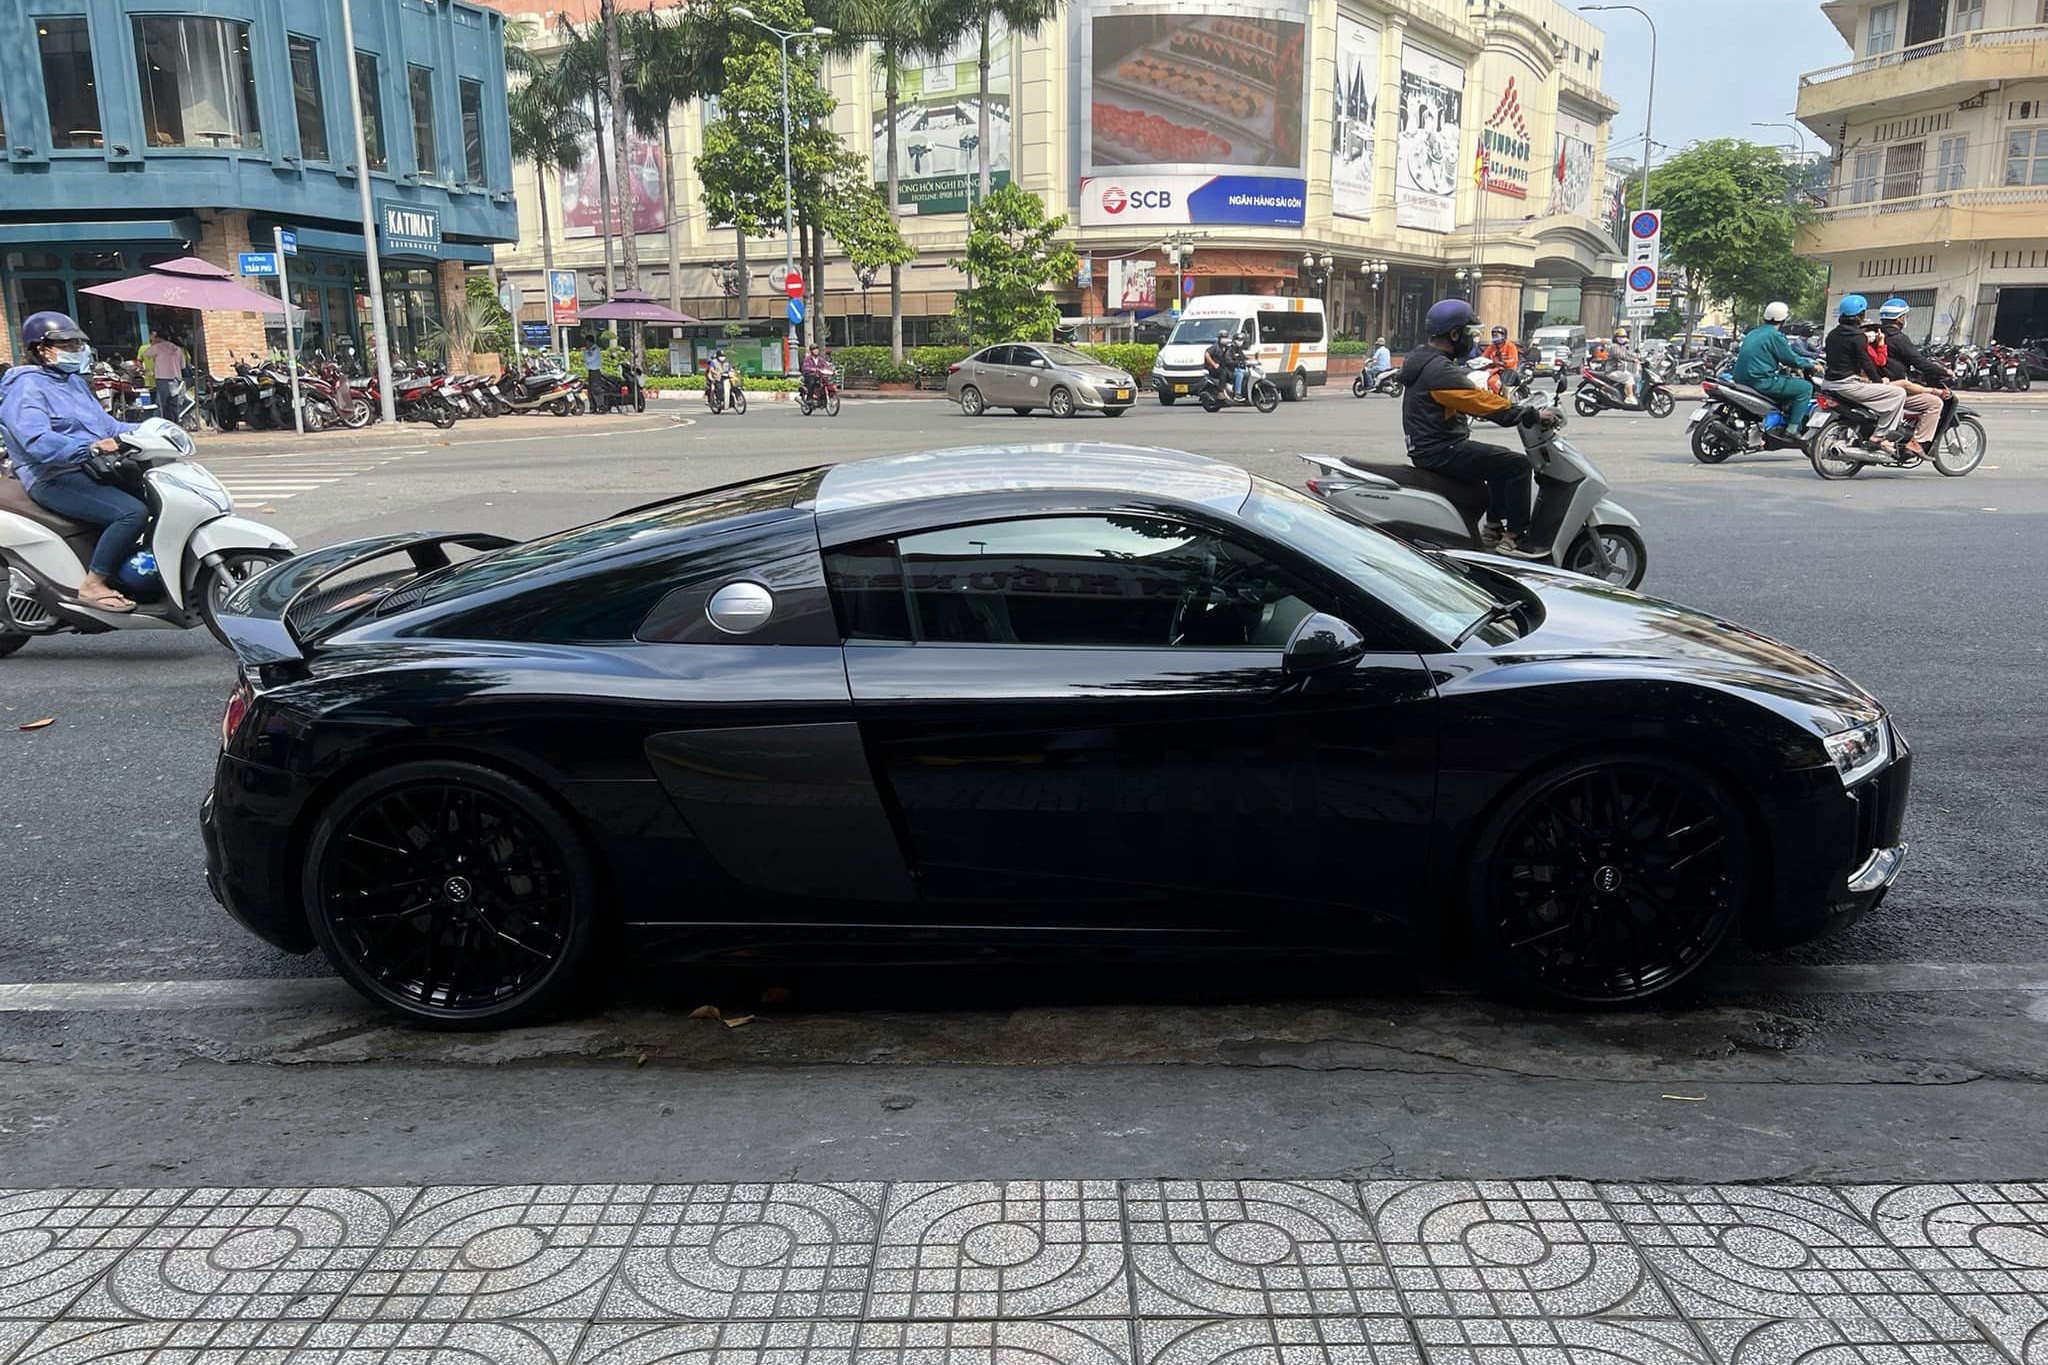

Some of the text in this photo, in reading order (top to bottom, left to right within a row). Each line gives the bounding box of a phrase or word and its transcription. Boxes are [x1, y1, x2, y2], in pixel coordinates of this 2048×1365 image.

[1484, 128, 1530, 162] WINDSOR
[1130, 190, 1172, 209] SCB
[1228, 193, 1253, 206] NGÂN
[1253, 194, 1275, 207] HÀNG
[1275, 195, 1287, 208] SÀI
[387, 210, 435, 238] KATINAT
